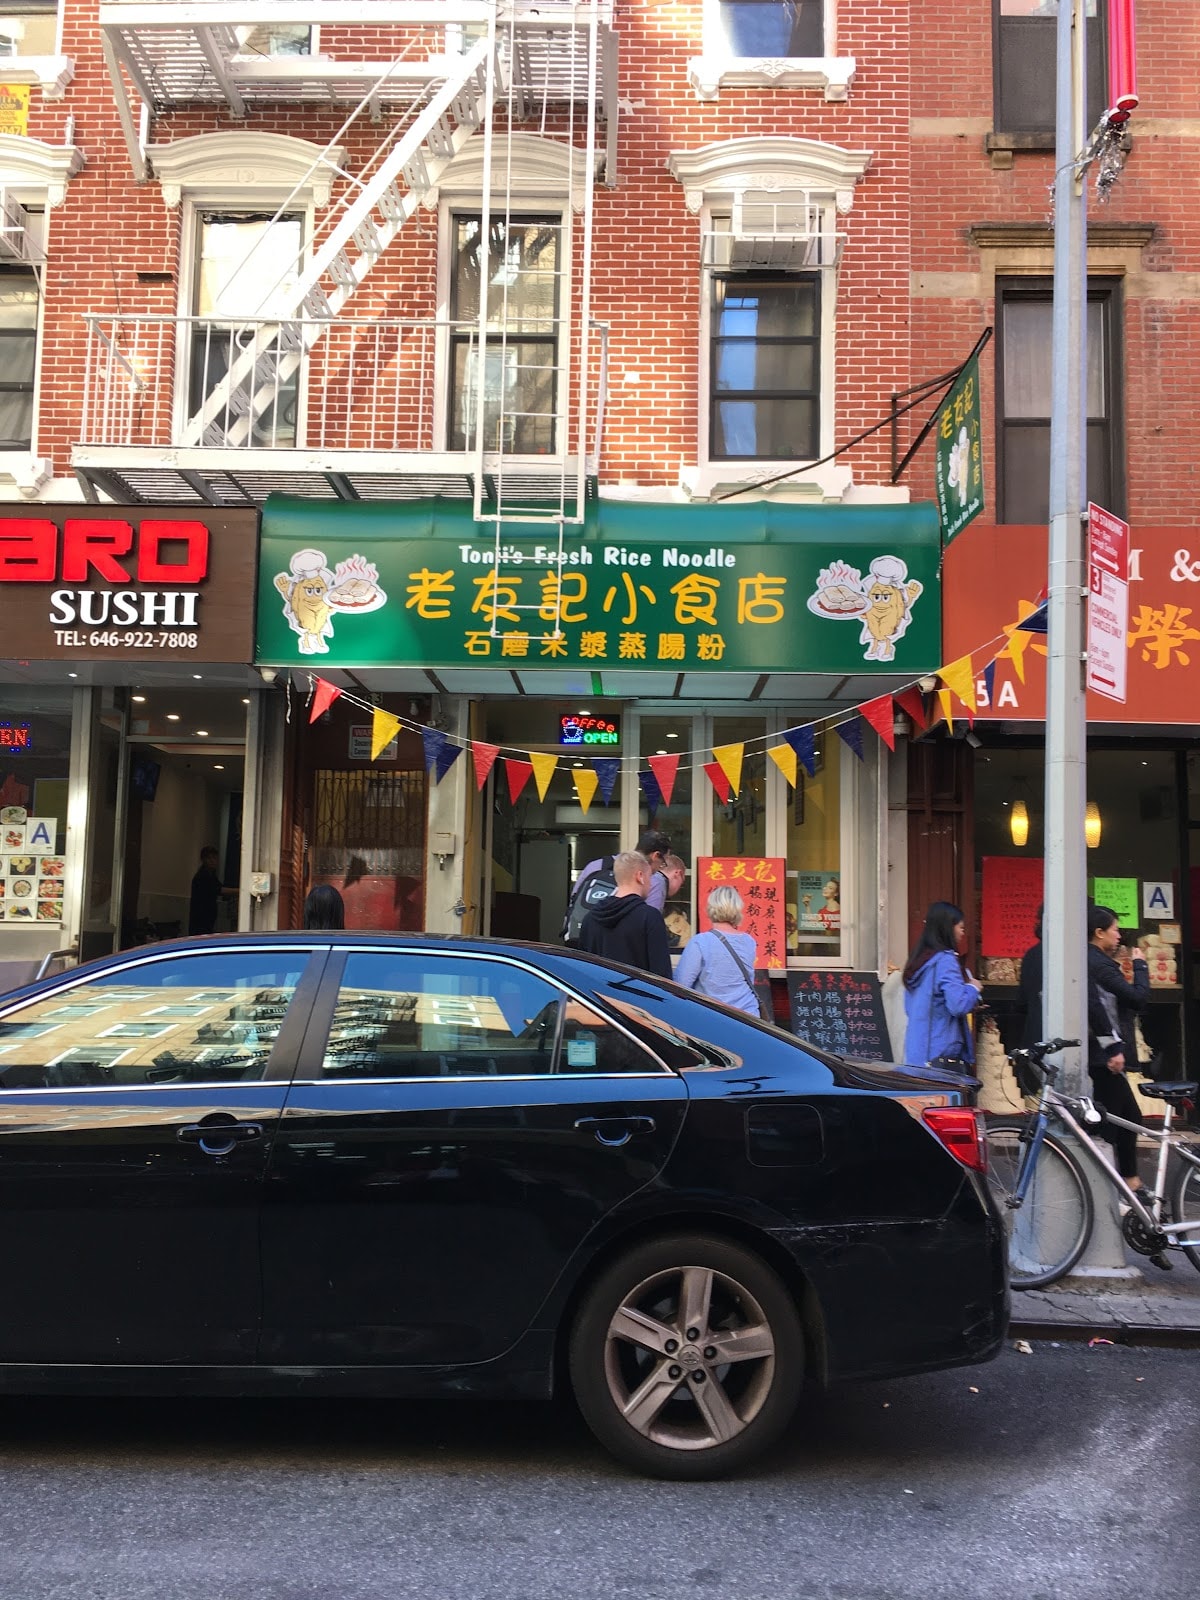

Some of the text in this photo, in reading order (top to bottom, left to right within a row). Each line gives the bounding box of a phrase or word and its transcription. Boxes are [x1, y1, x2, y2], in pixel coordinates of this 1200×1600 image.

[1099, 514, 1124, 537] STANDING
[534, 546, 593, 565] Fresh
[604, 547, 652, 566] Rice
[662, 547, 736, 568] Noodle
[1092, 566, 1101, 592] 3
[50, 590, 200, 626] SUSHI
[405, 567, 788, 626] 老友記小食店
[54, 630, 198, 649] TEL: 646-922-7808
[463, 630, 727, 661] 石磨米漿蒸腸粉
[960, 680, 1020, 708] 5A
[583, 732, 618, 744] OPEN
[30, 822, 50, 844] A
[1148, 886, 1169, 909] A
